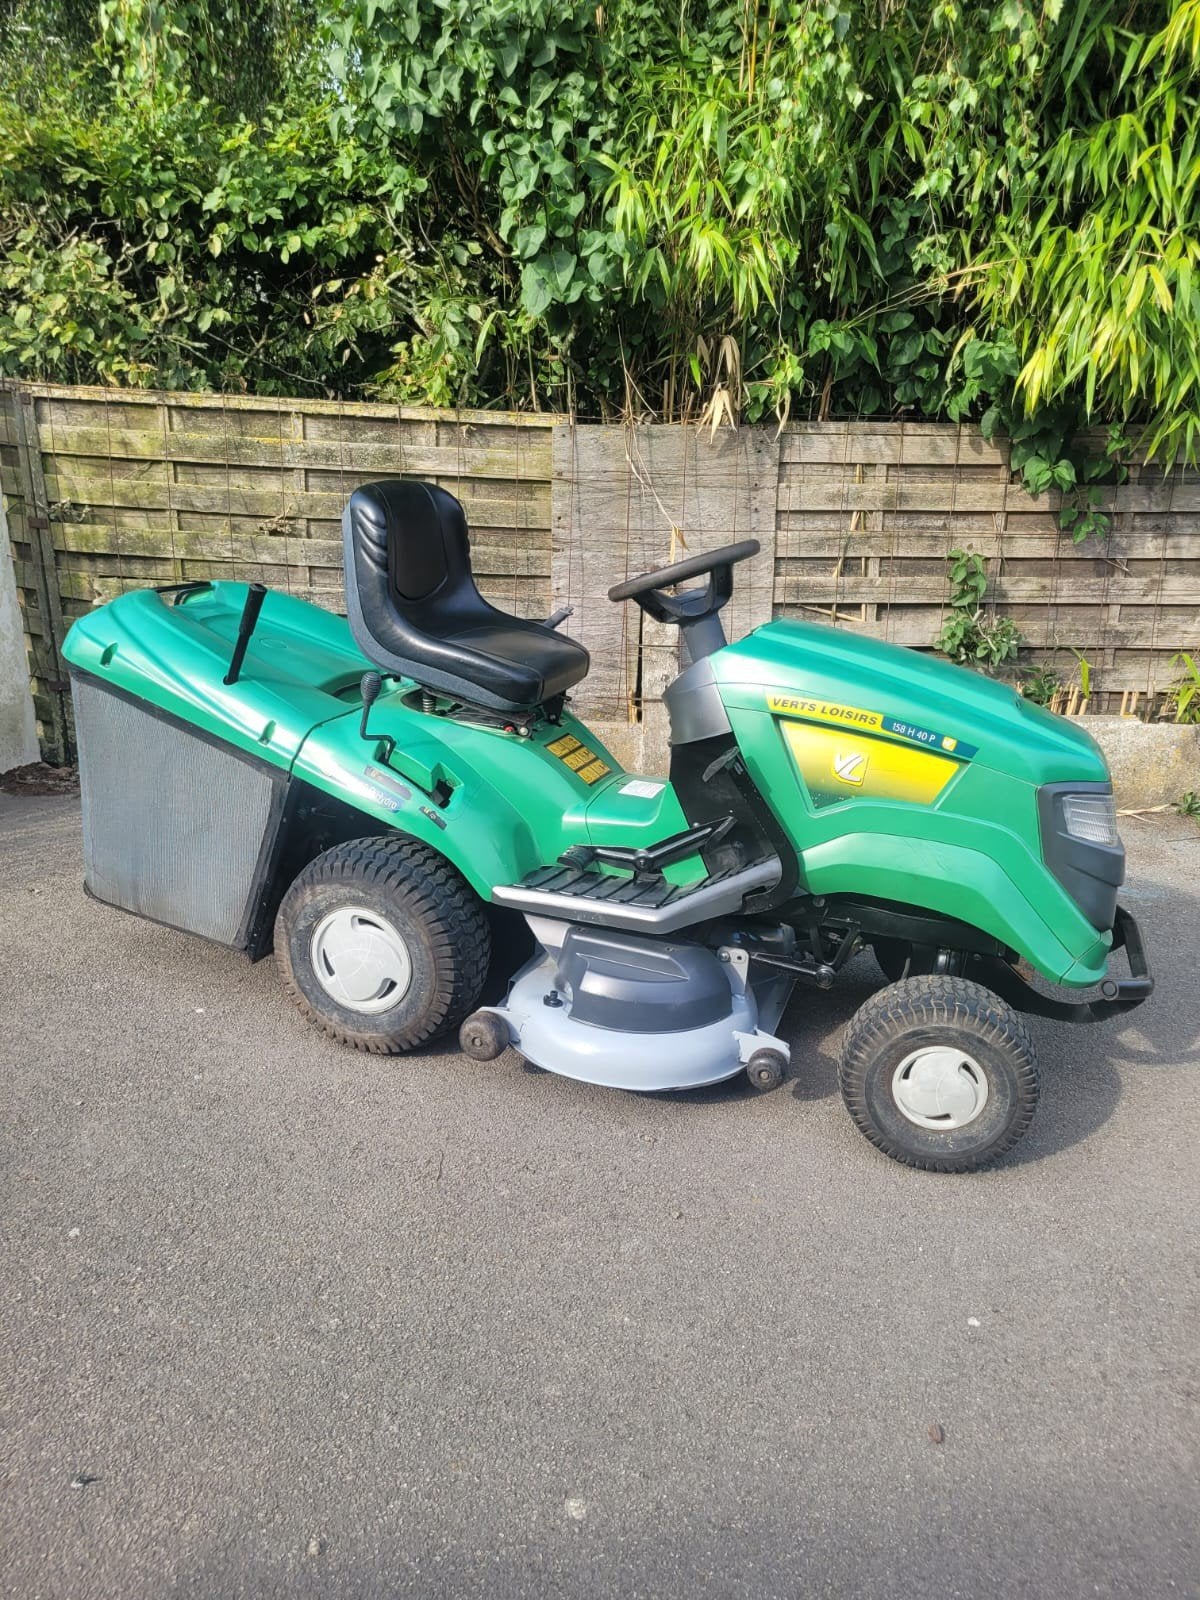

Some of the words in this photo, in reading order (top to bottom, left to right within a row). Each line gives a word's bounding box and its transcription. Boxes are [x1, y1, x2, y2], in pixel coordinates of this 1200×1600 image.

[773, 697, 816, 712] VERTS
[821, 706, 877, 725] LOISIRS
[892, 722, 905, 734] 158
[907, 728, 915, 737] H
[917, 730, 928, 741] 40
[928, 734, 936, 743] P
